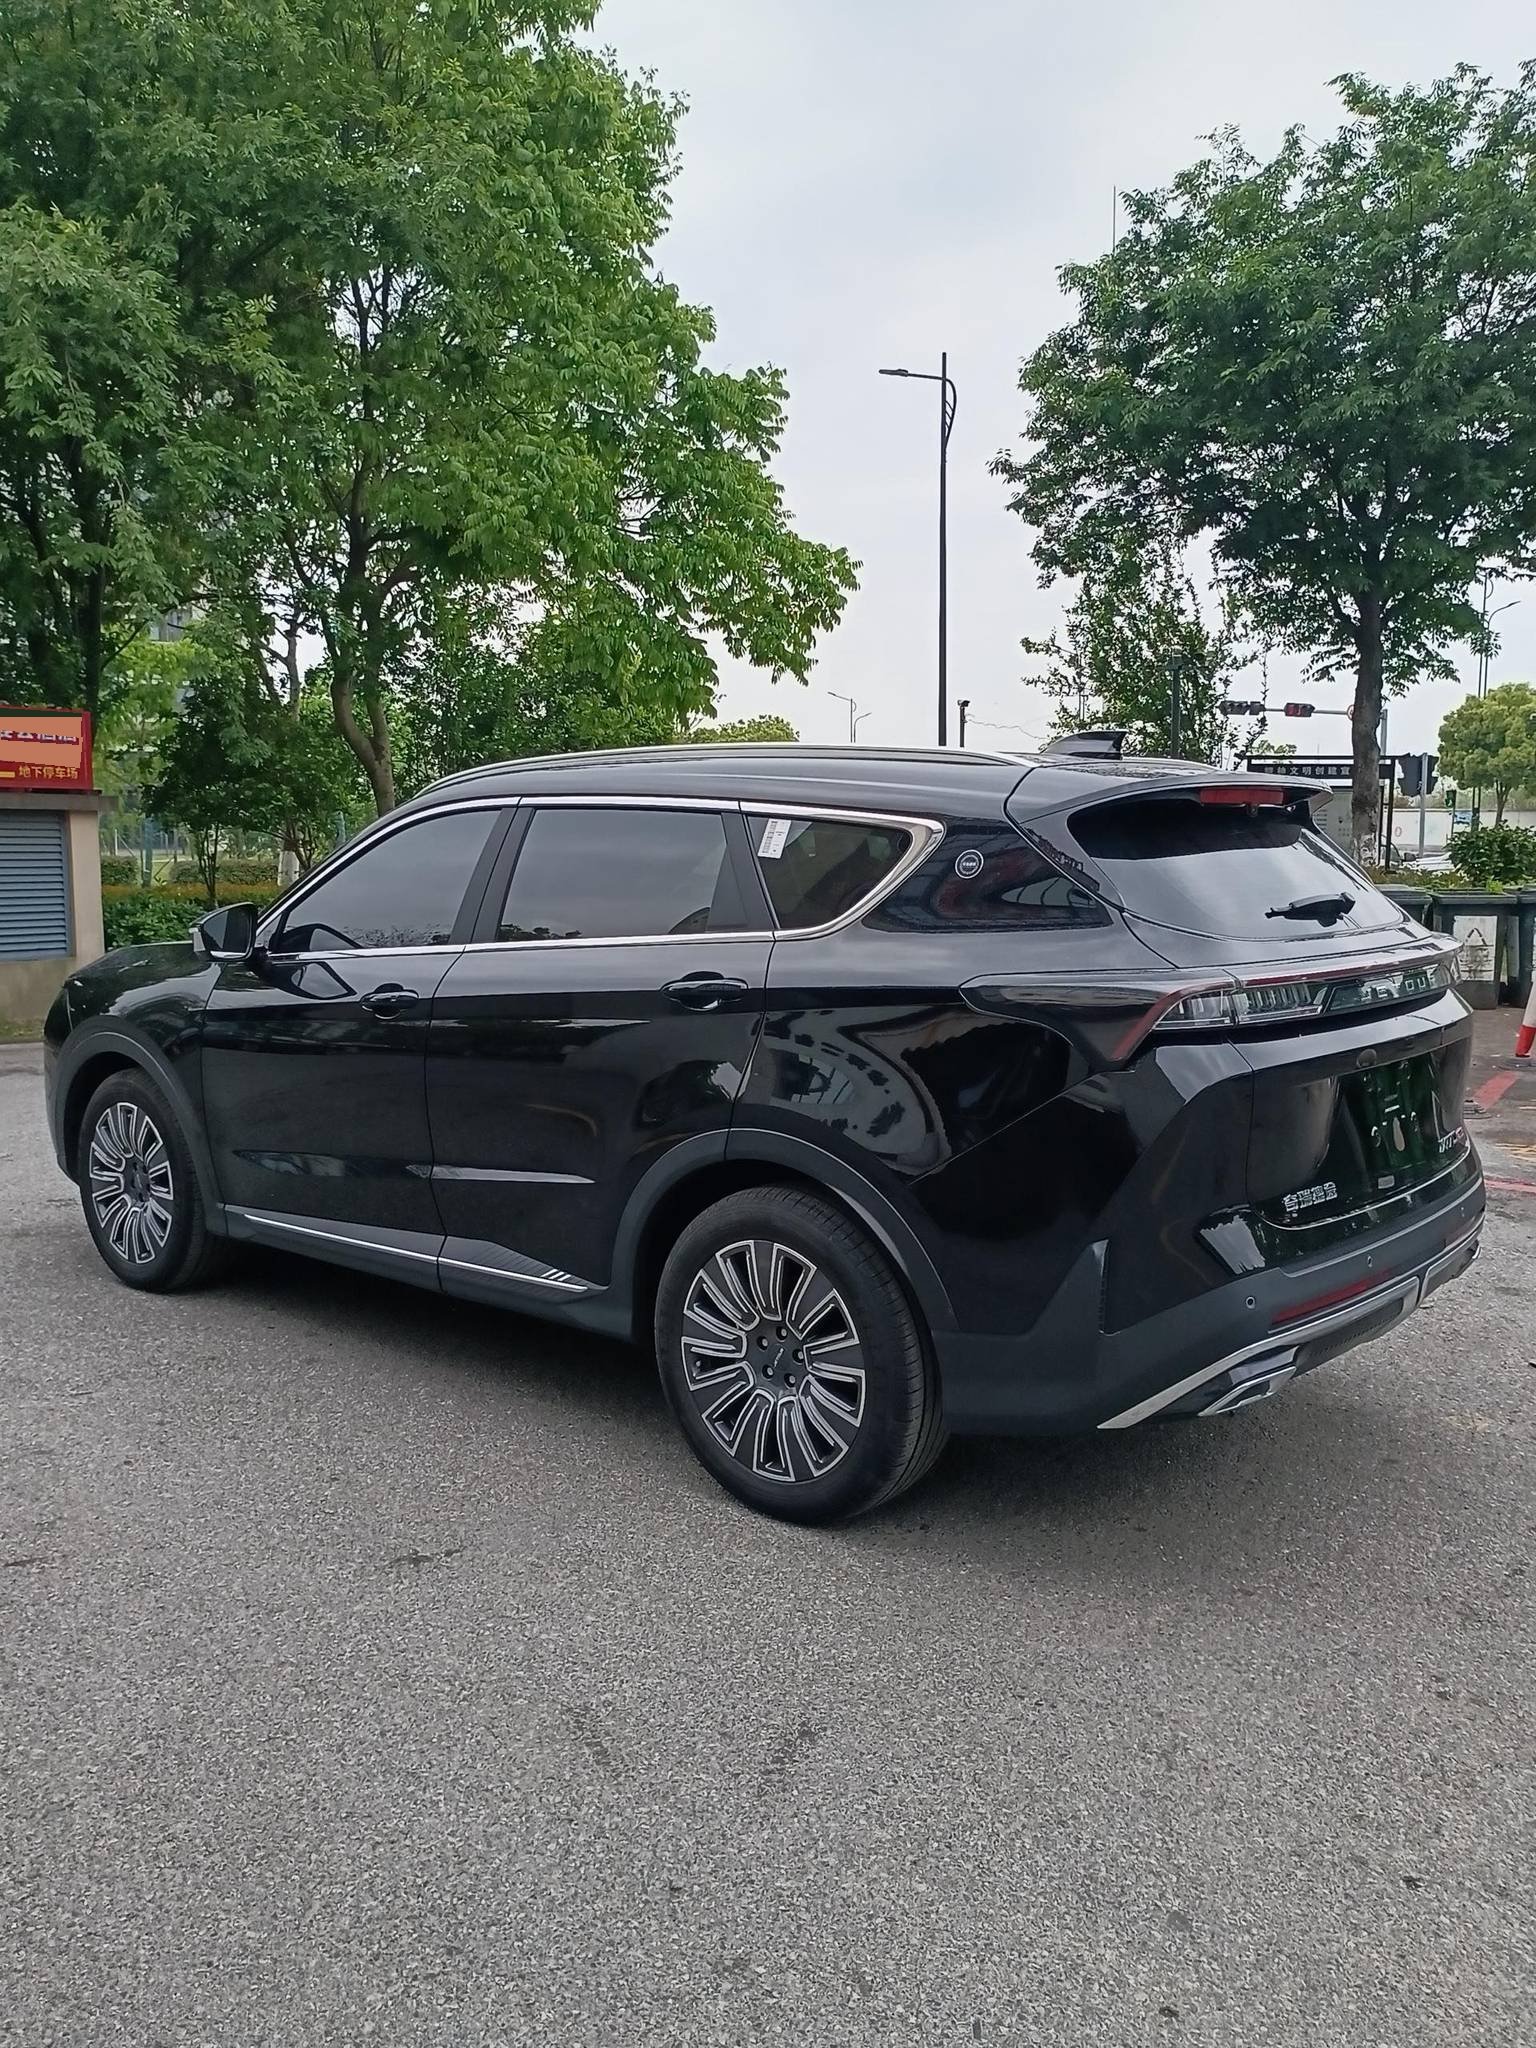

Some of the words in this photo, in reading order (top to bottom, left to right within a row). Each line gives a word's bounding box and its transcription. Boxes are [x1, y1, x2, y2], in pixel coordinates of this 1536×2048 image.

[18, 765, 79, 779] 地下停车场
